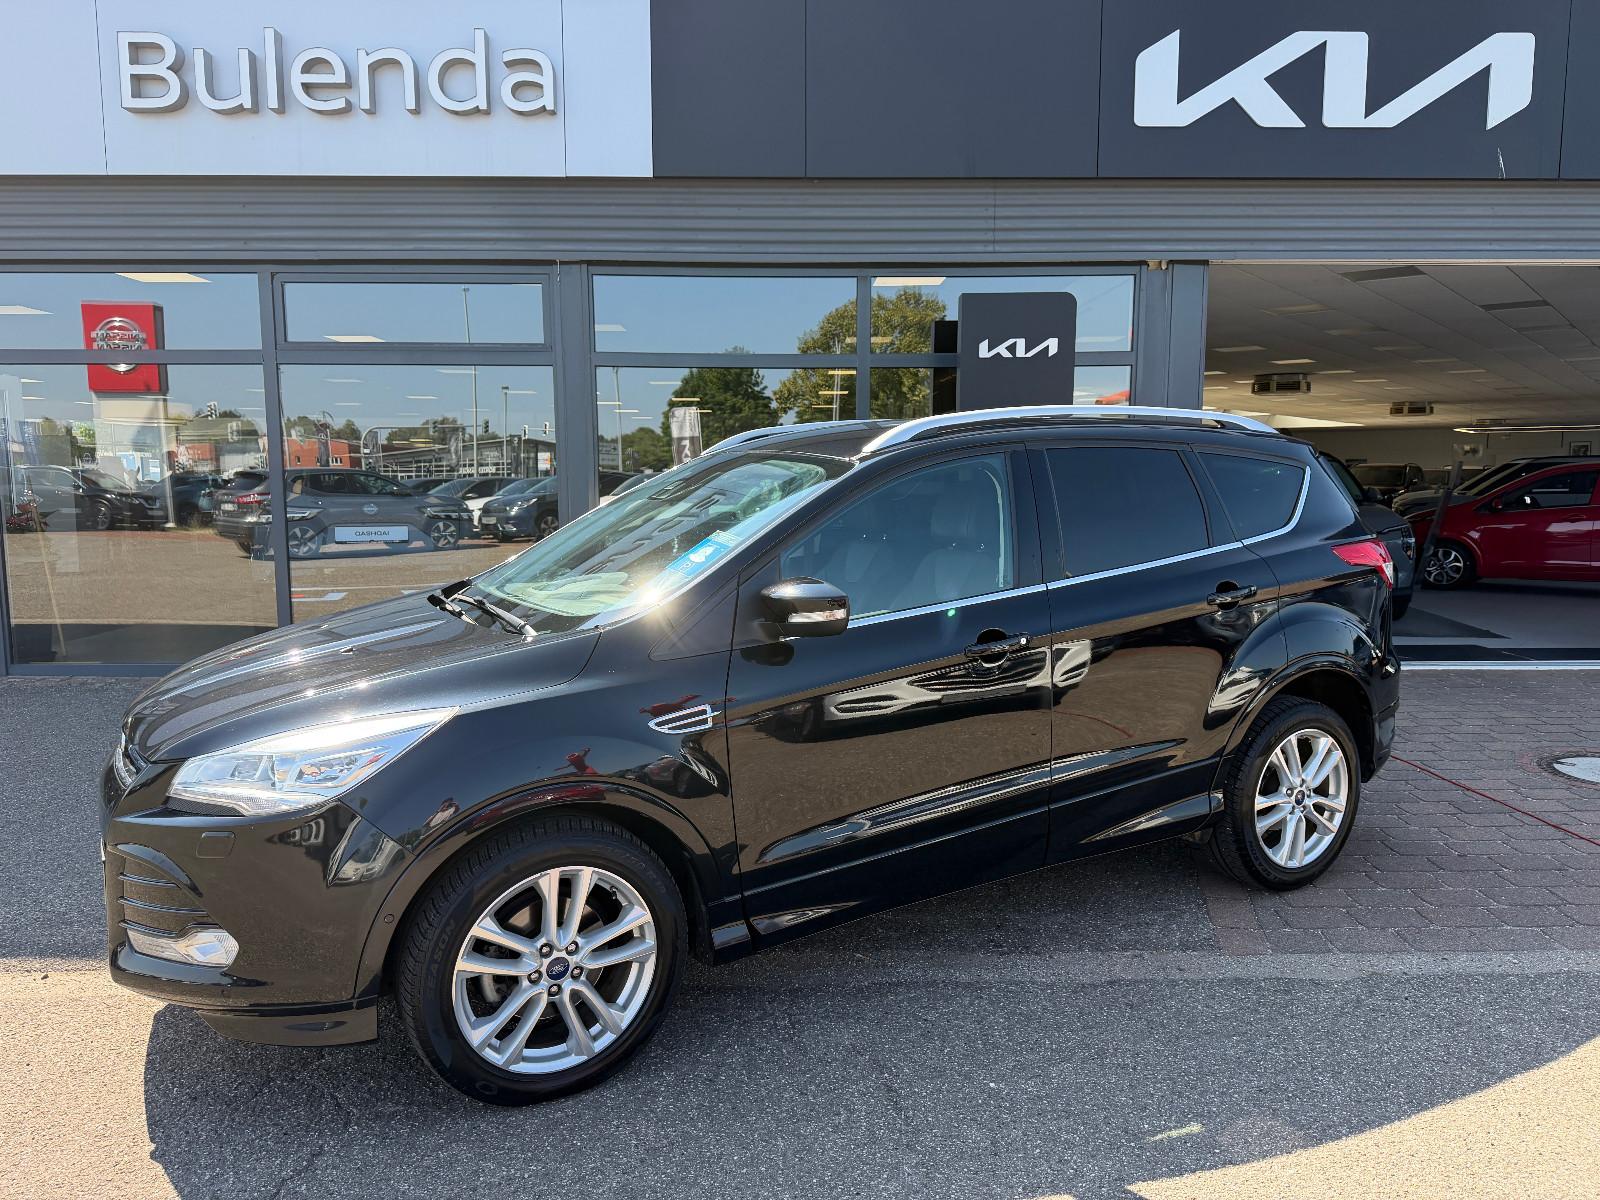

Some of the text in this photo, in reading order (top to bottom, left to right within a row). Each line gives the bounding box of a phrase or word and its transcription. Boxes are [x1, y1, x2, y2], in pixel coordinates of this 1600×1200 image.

[117, 27, 557, 116] Bulenda
[1134, 29, 1536, 130] KIA
[978, 337, 1059, 359] KIA
